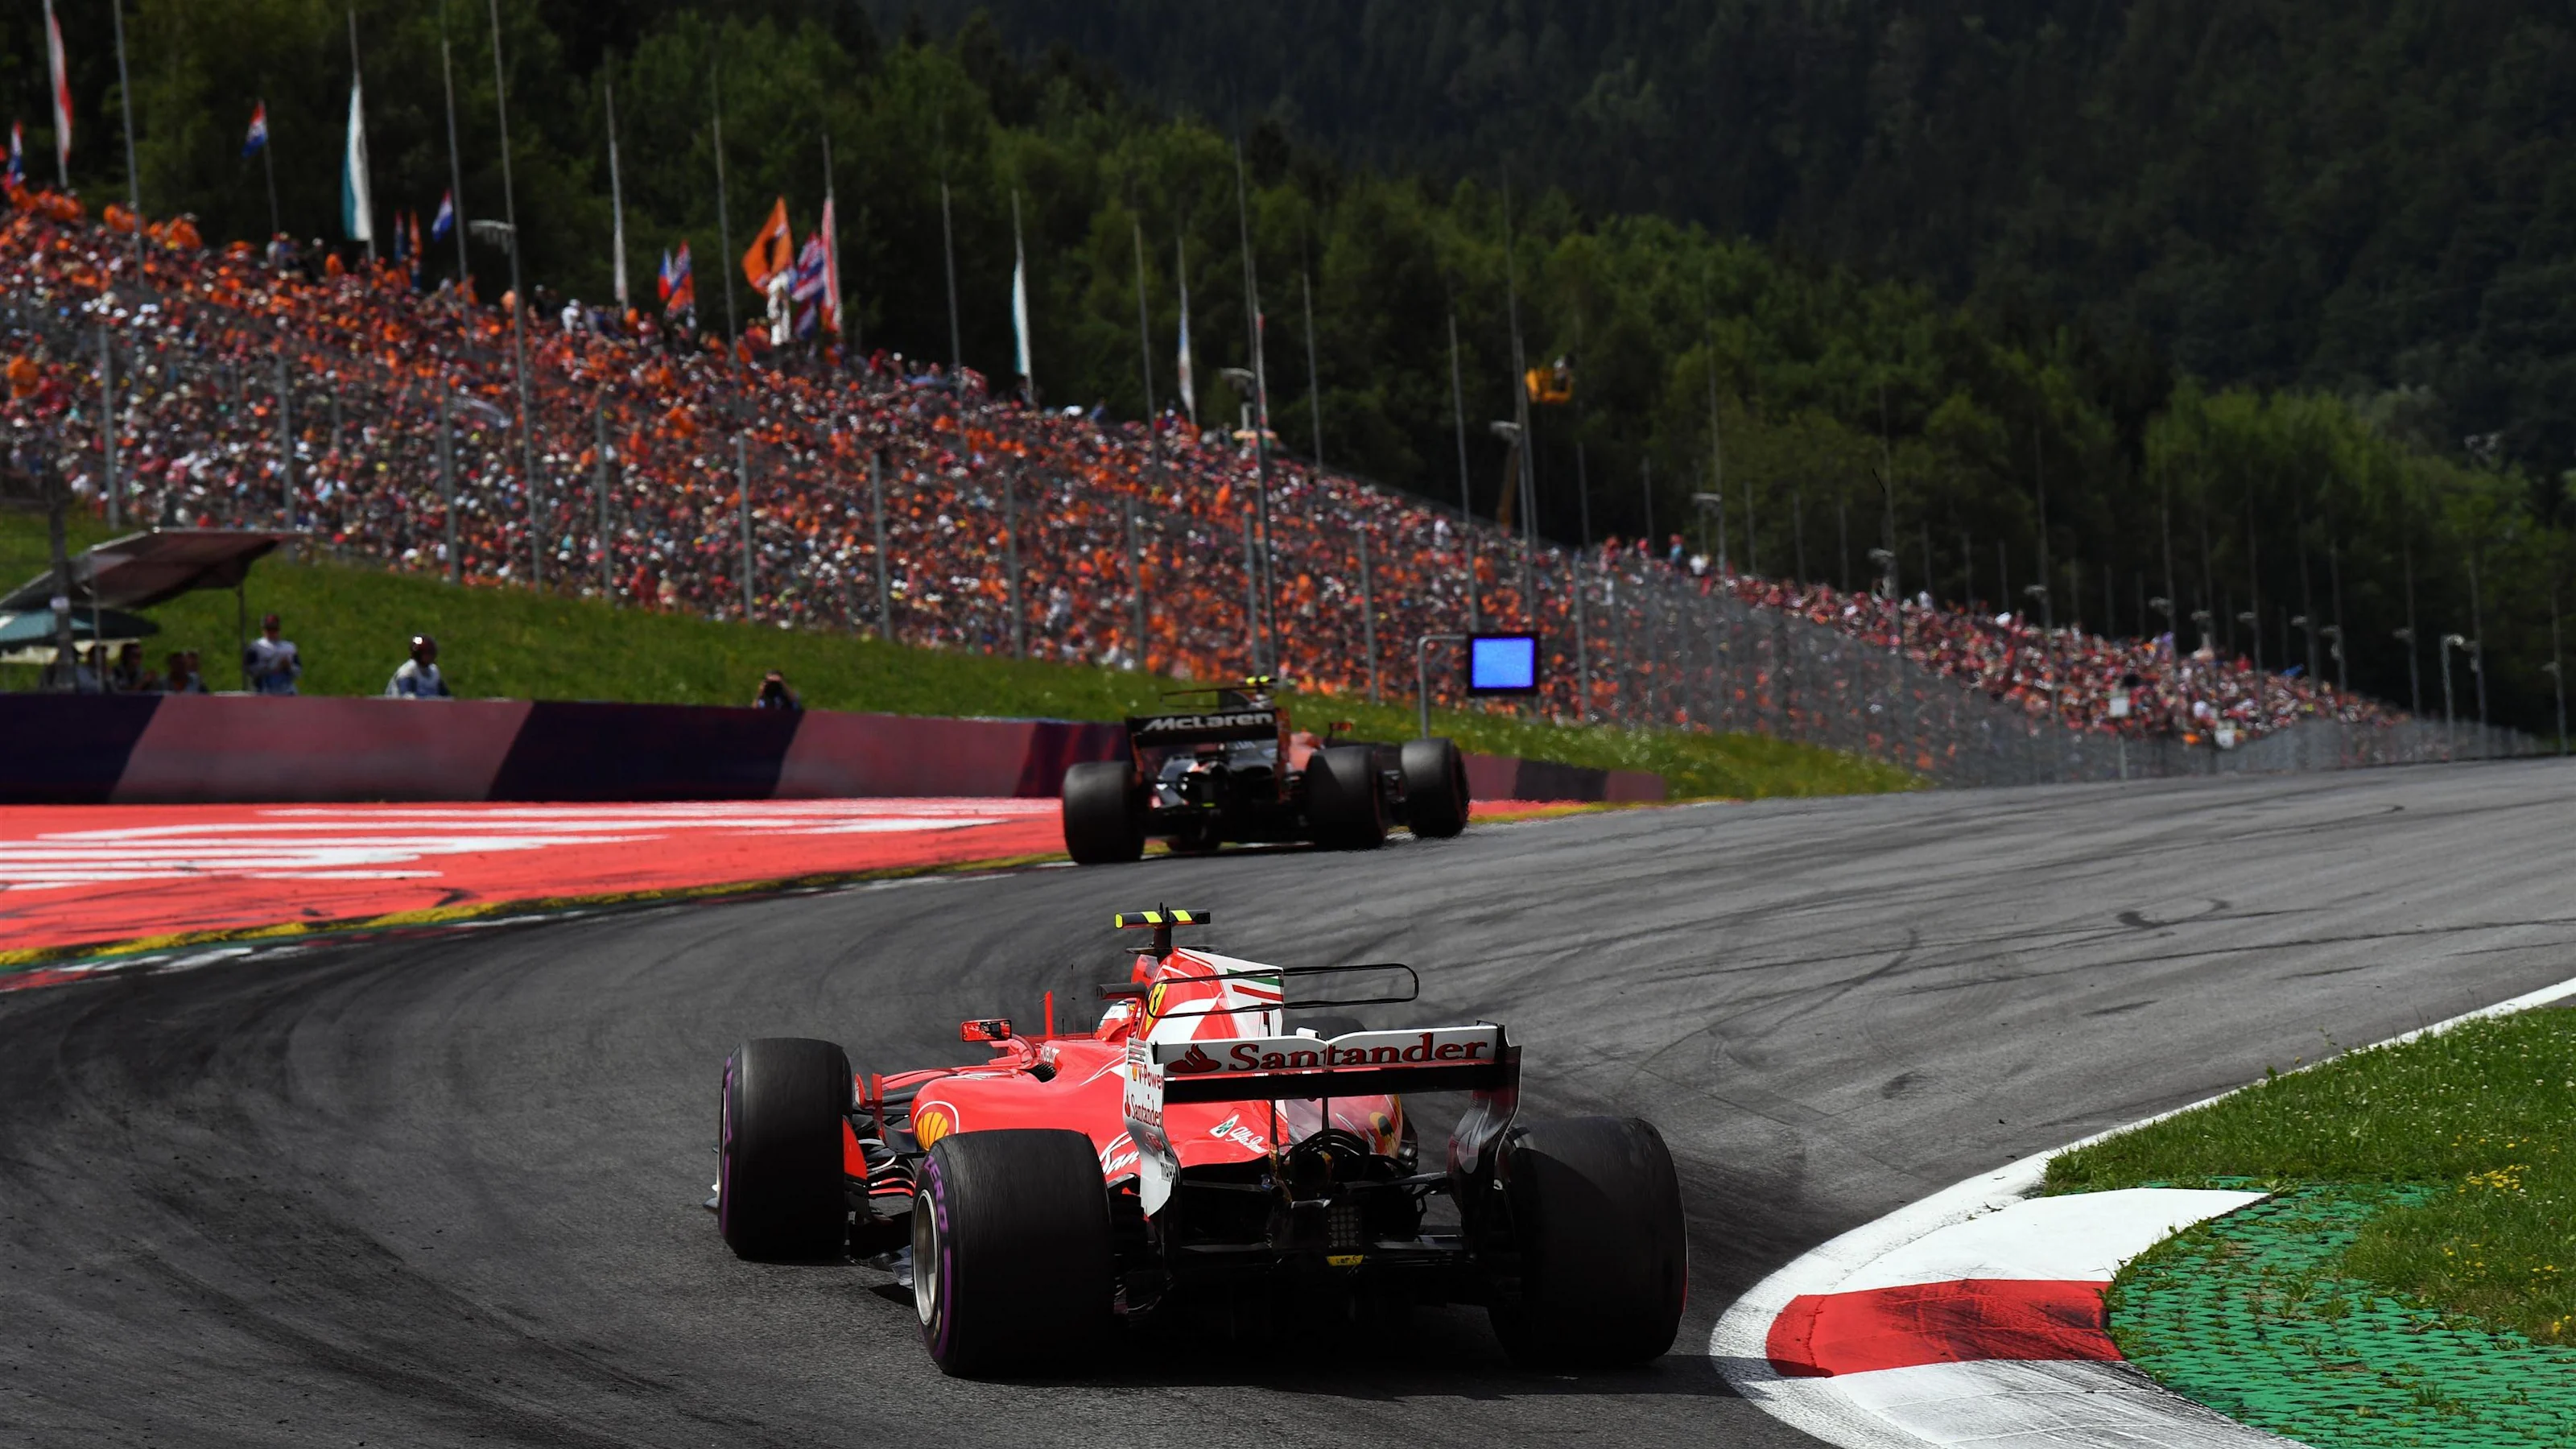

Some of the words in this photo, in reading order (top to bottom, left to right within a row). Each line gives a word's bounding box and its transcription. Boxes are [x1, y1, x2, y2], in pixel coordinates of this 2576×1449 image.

[1143, 712, 1274, 731] McLaren
[1228, 1032, 1488, 1071] Santander
[1131, 1093, 1163, 1127] Santander
